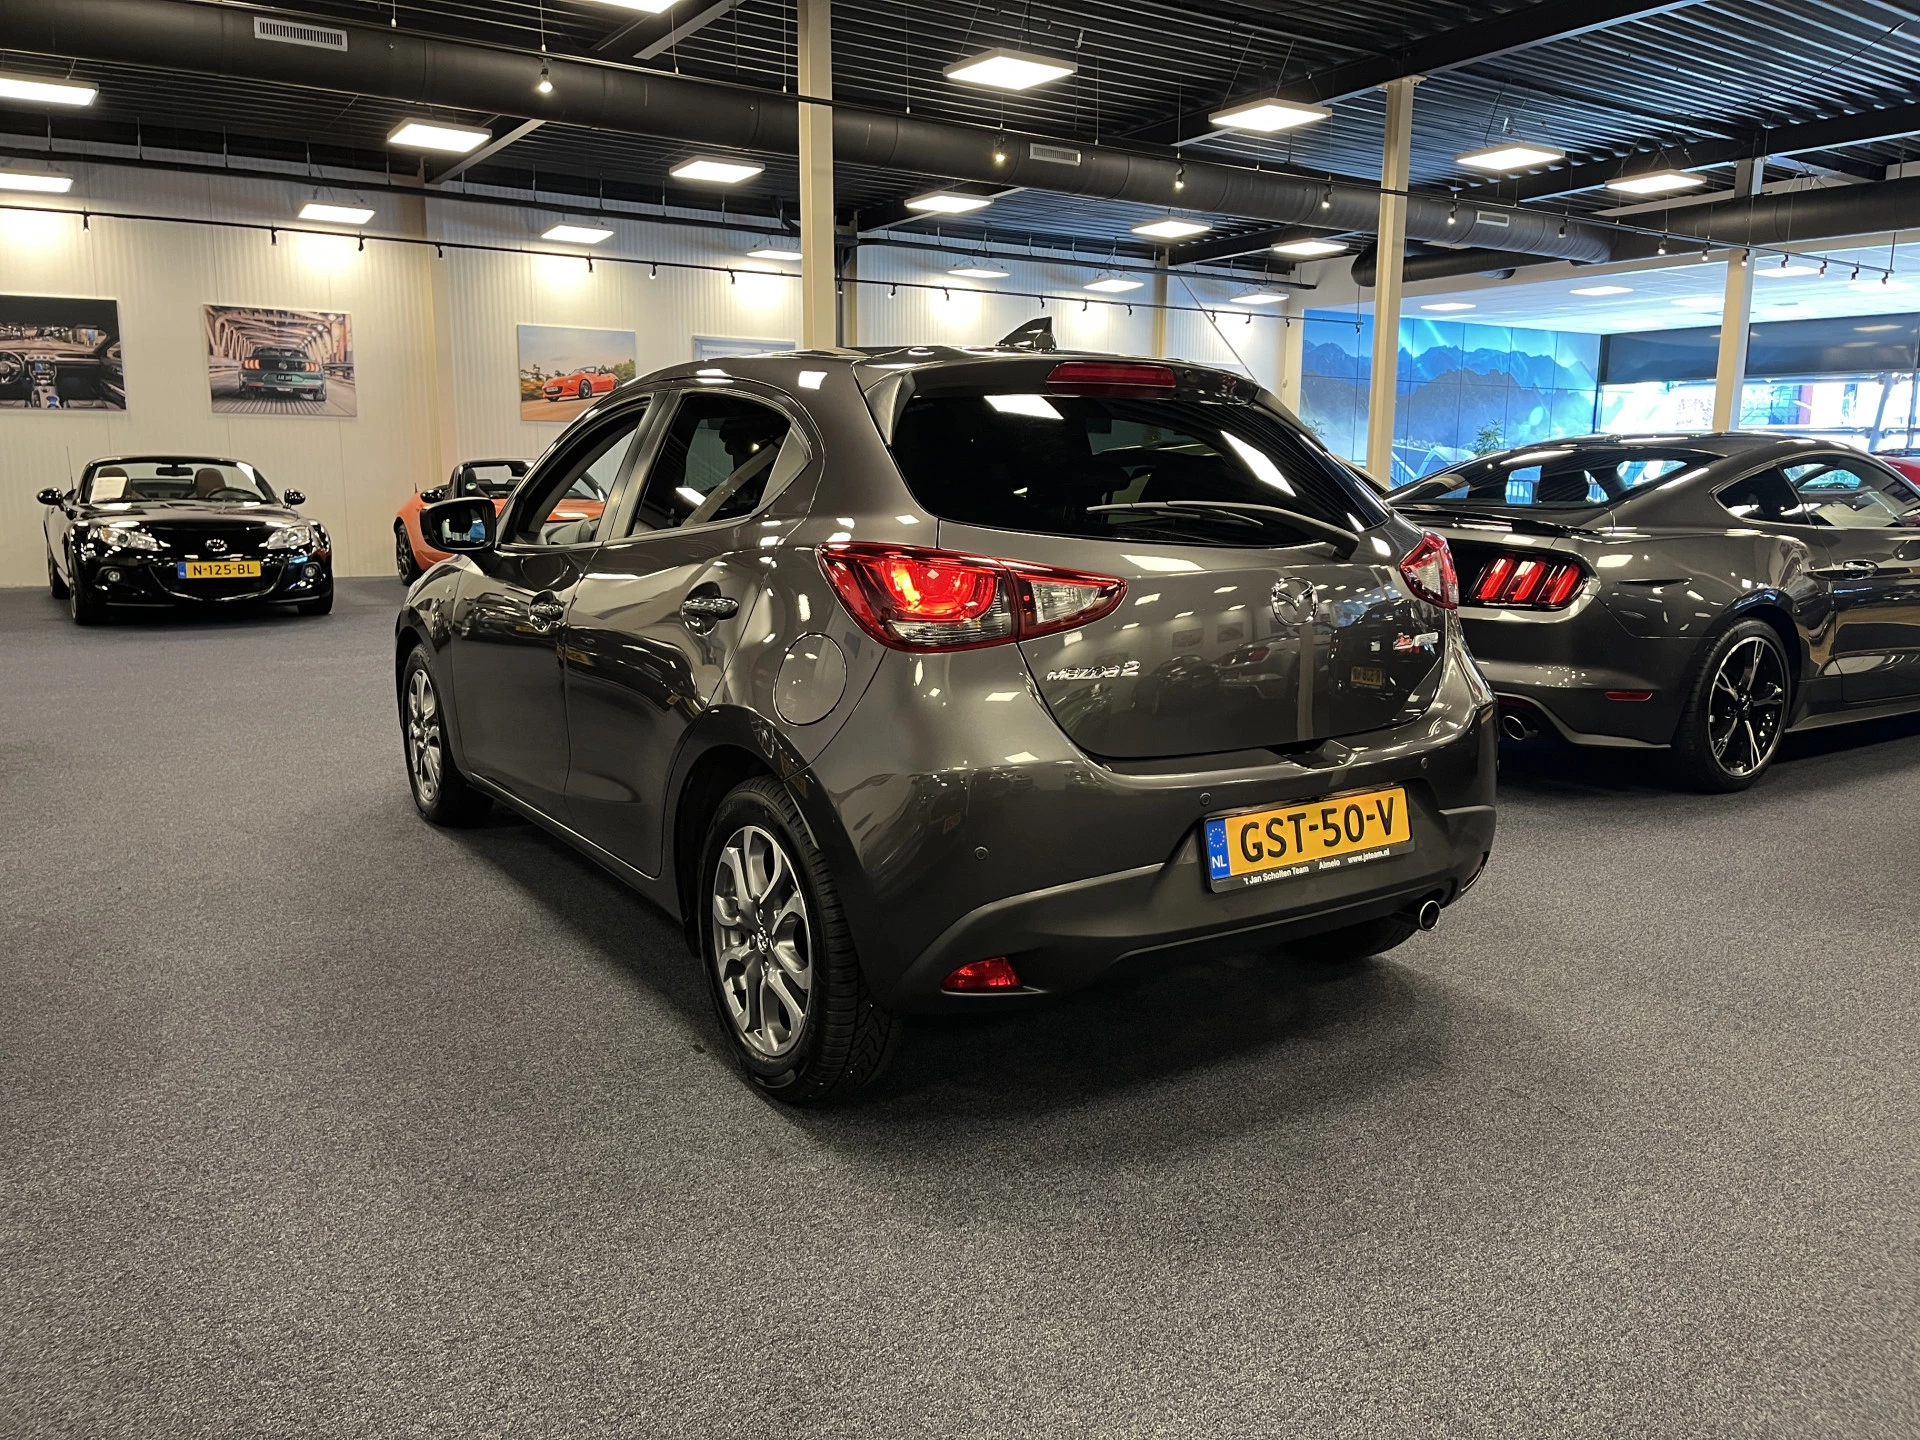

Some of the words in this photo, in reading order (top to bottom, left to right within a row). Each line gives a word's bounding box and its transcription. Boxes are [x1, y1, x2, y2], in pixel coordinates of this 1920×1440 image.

[193, 564, 254, 576] N-125-BL
[1240, 797, 1394, 863] GST-50-V
[1211, 855, 1227, 869] NL
[1249, 875, 1262, 884] Jan
[1262, 870, 1292, 882] Scholten
[1291, 866, 1309, 876] Team
[1318, 859, 1341, 870] Almelo
[1347, 848, 1390, 864] www.jsteam.nl
